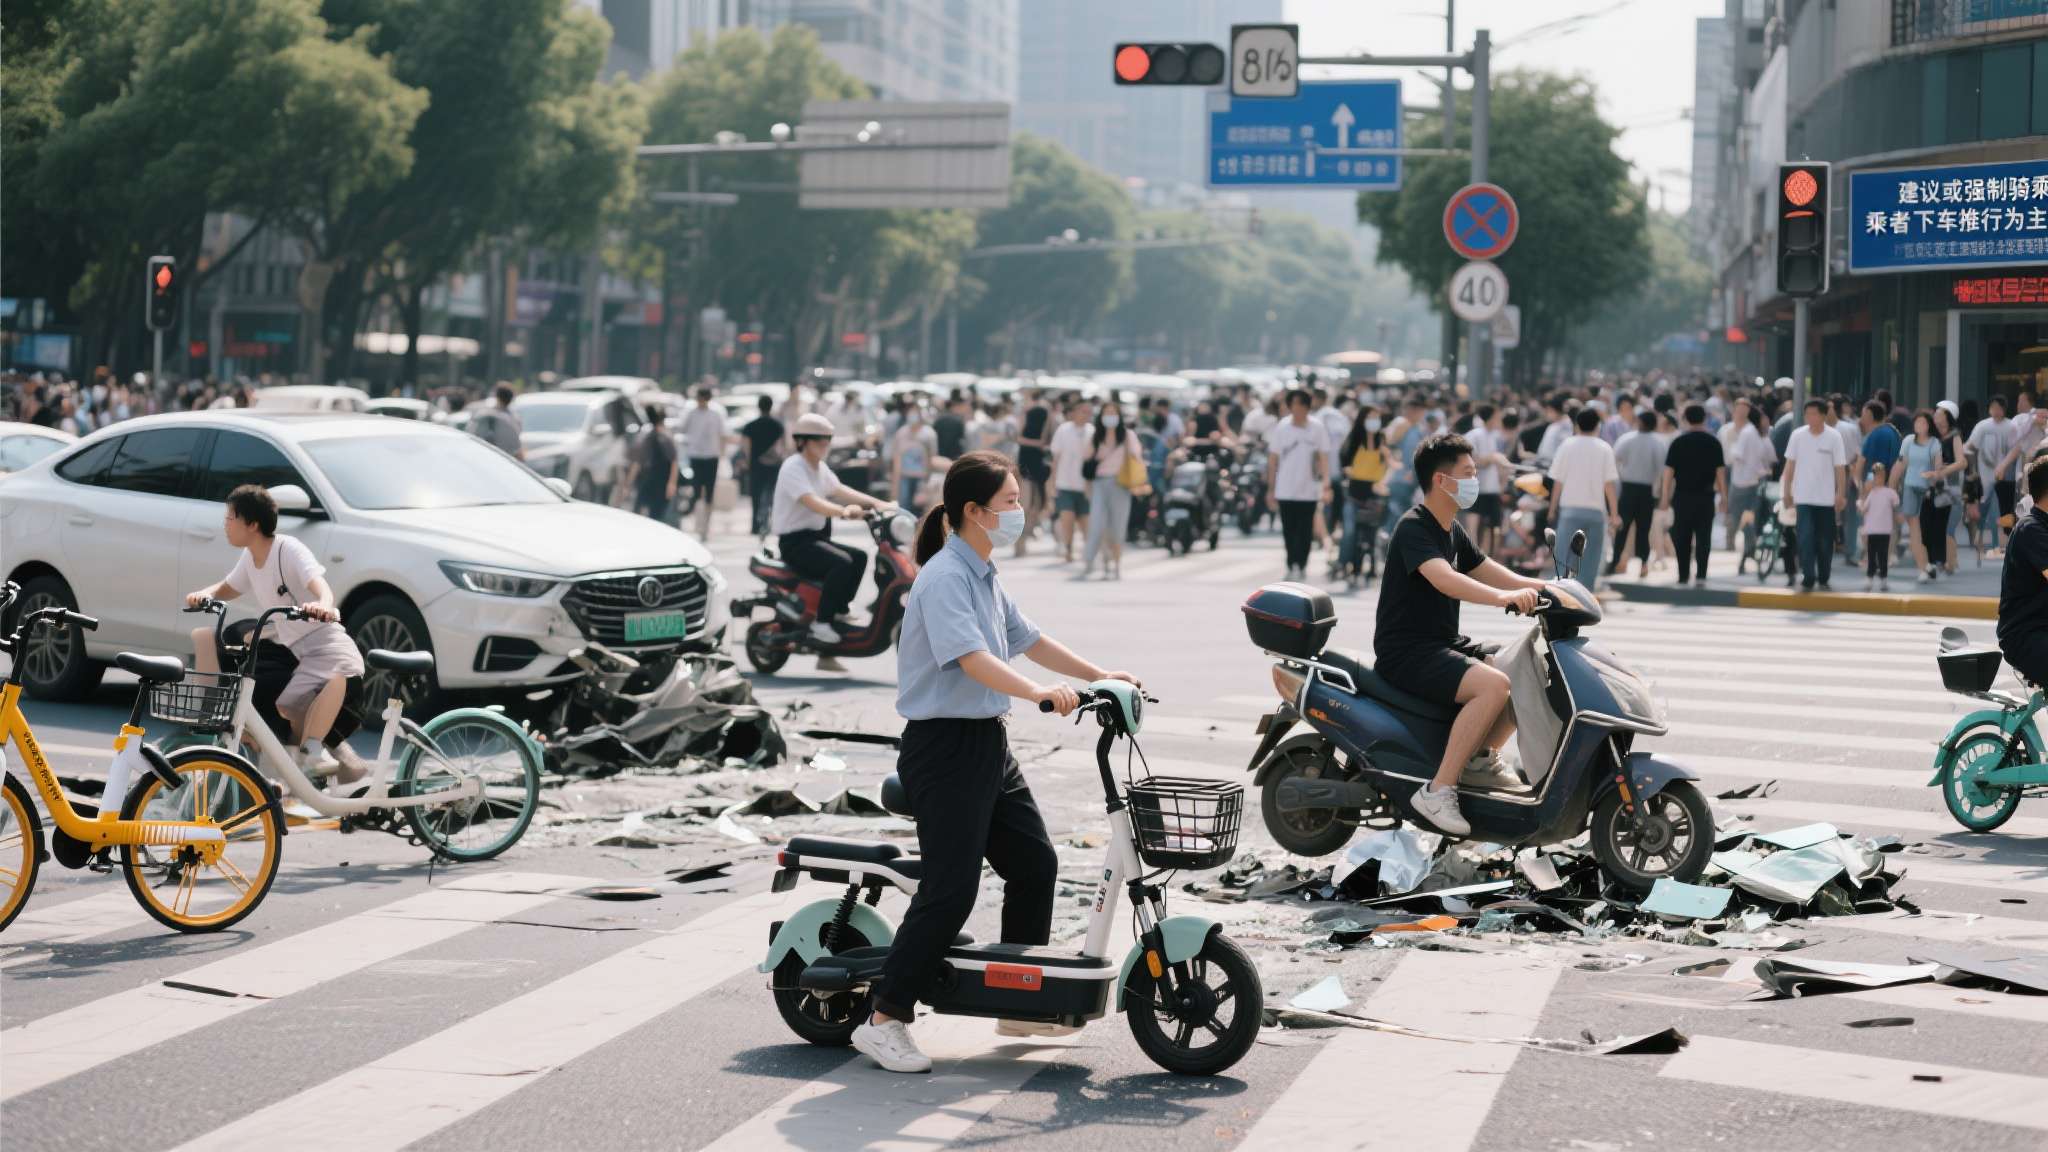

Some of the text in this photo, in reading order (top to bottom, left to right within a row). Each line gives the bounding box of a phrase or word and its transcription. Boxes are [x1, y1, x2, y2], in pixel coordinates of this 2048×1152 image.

[1899, 175, 2048, 204] 建议或强制骑乘
[1866, 206, 2047, 236] 乘者下车推行为主
[1460, 276, 1496, 305] 40
